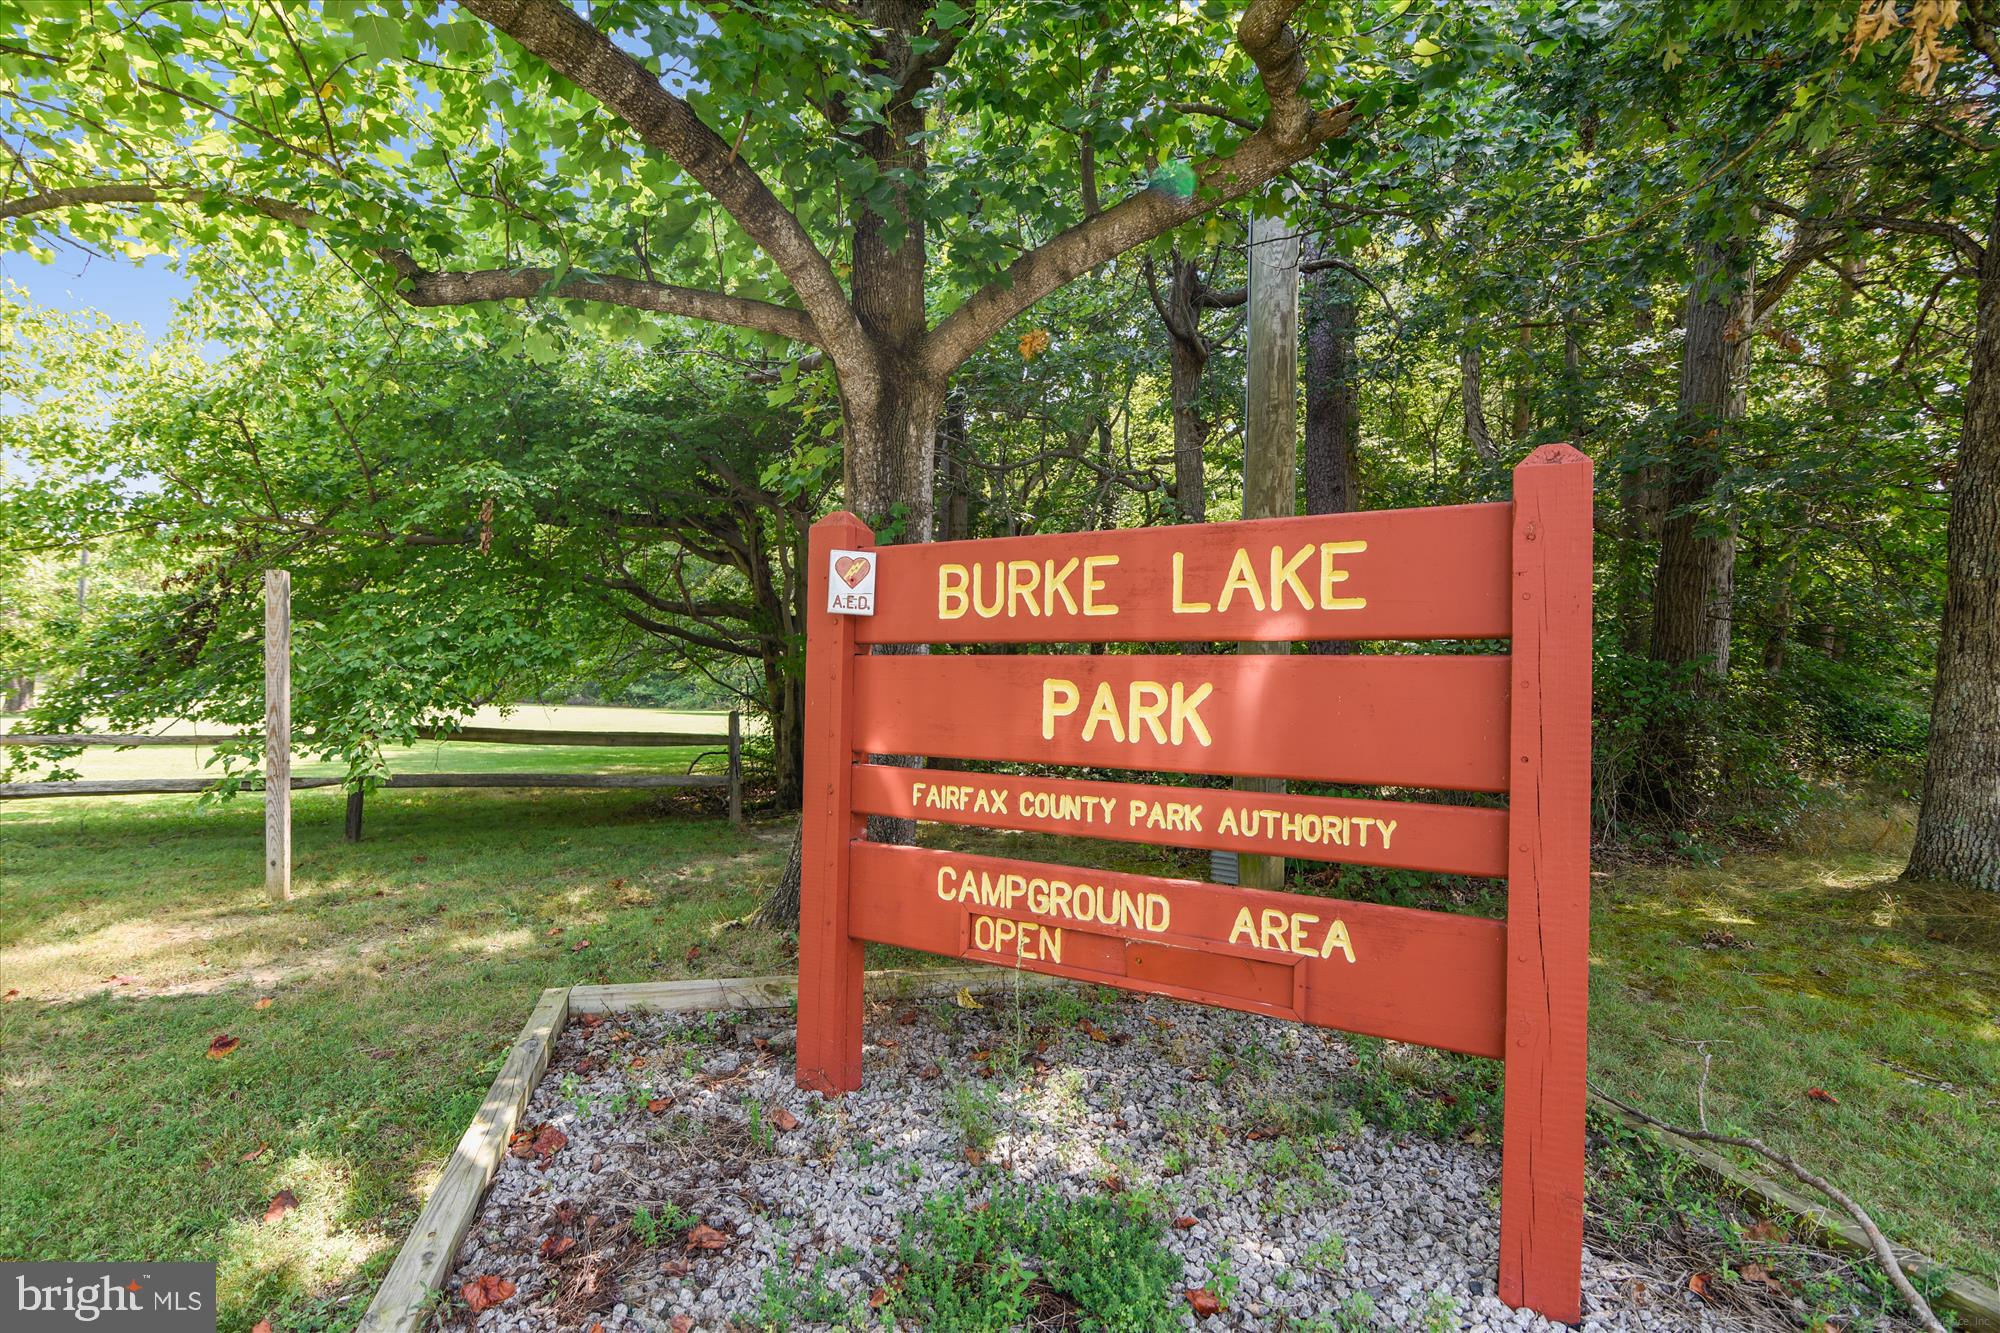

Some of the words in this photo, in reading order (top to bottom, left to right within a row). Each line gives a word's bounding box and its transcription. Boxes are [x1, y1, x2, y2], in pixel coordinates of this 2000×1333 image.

[832, 594, 871, 611] A.E.D.
[938, 554, 1120, 620] BURKE
[1172, 540, 1368, 614] LAKE
[1041, 677, 1214, 748] PARK
[911, 782, 1009, 815] FAIRFAX
[1019, 791, 1117, 825] COUNTY
[1129, 799, 1204, 833] PARK
[1217, 807, 1398, 850] AUTHORITY
[937, 866, 1171, 933] CAMPGROUND
[1228, 906, 1357, 964] AREA
[974, 915, 1062, 964] OPEN
